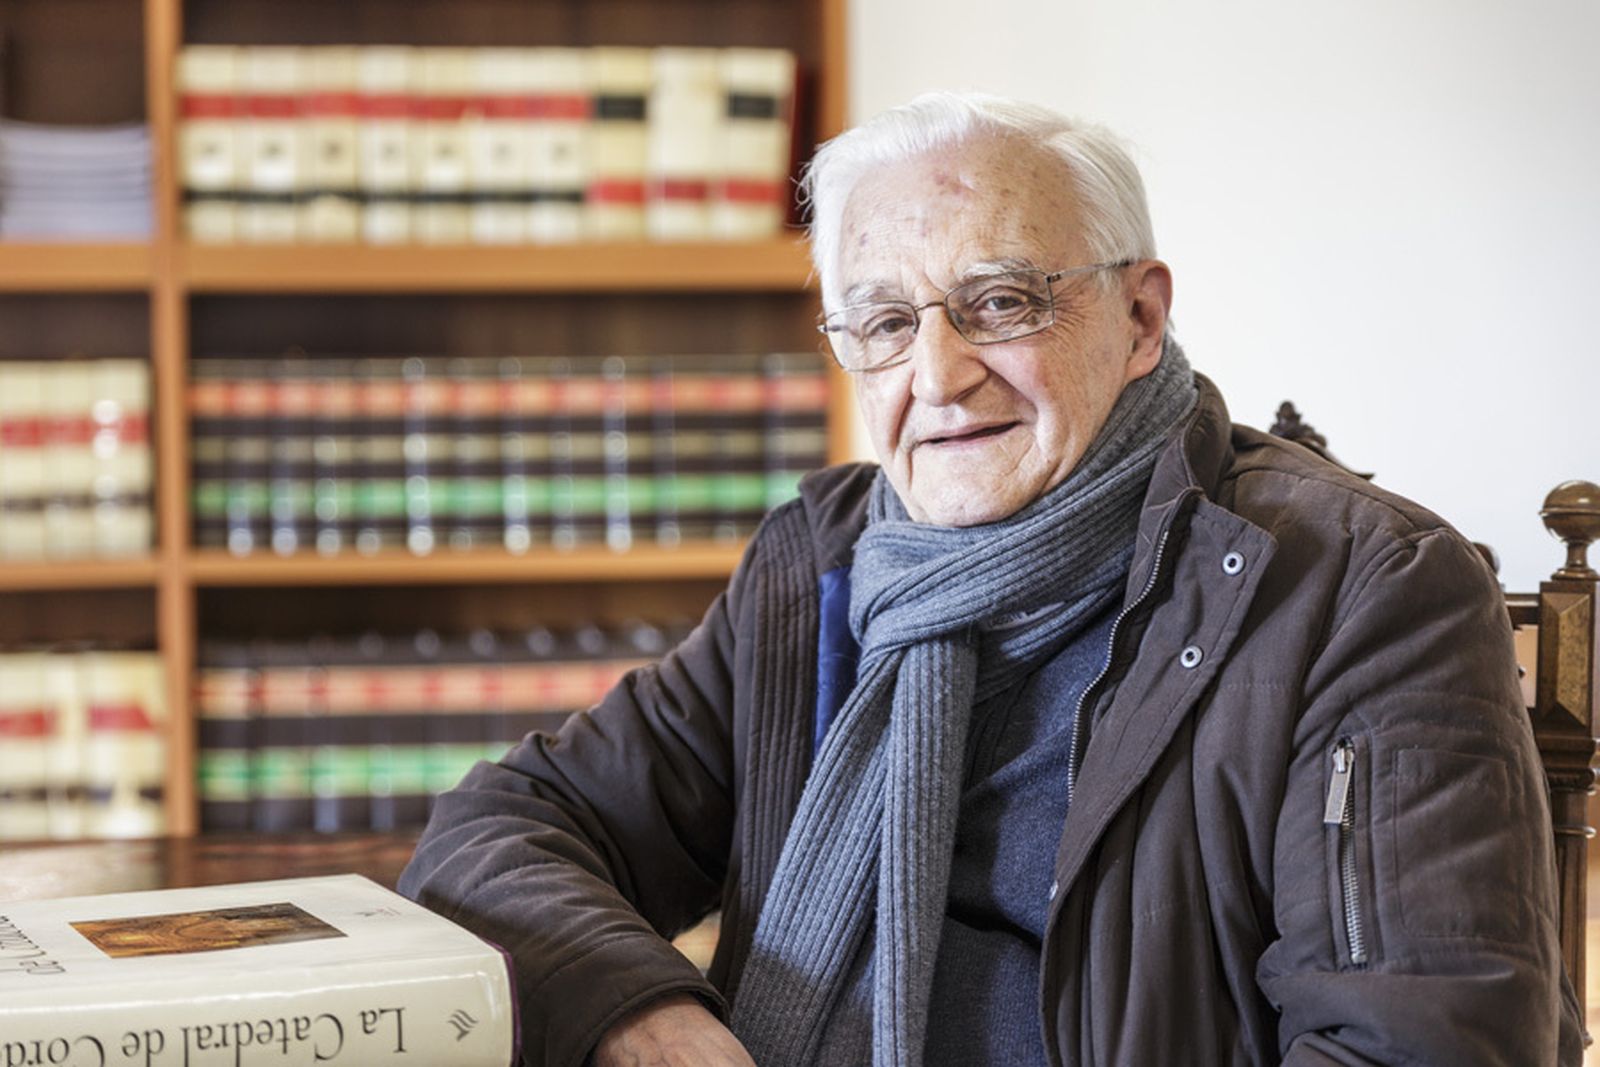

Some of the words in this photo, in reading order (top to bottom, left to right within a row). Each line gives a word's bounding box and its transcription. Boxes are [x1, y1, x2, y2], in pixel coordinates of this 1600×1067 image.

[121, 1028, 164, 1067] de
[181, 1013, 344, 1067] Catedral
[359, 1008, 405, 1053] La
